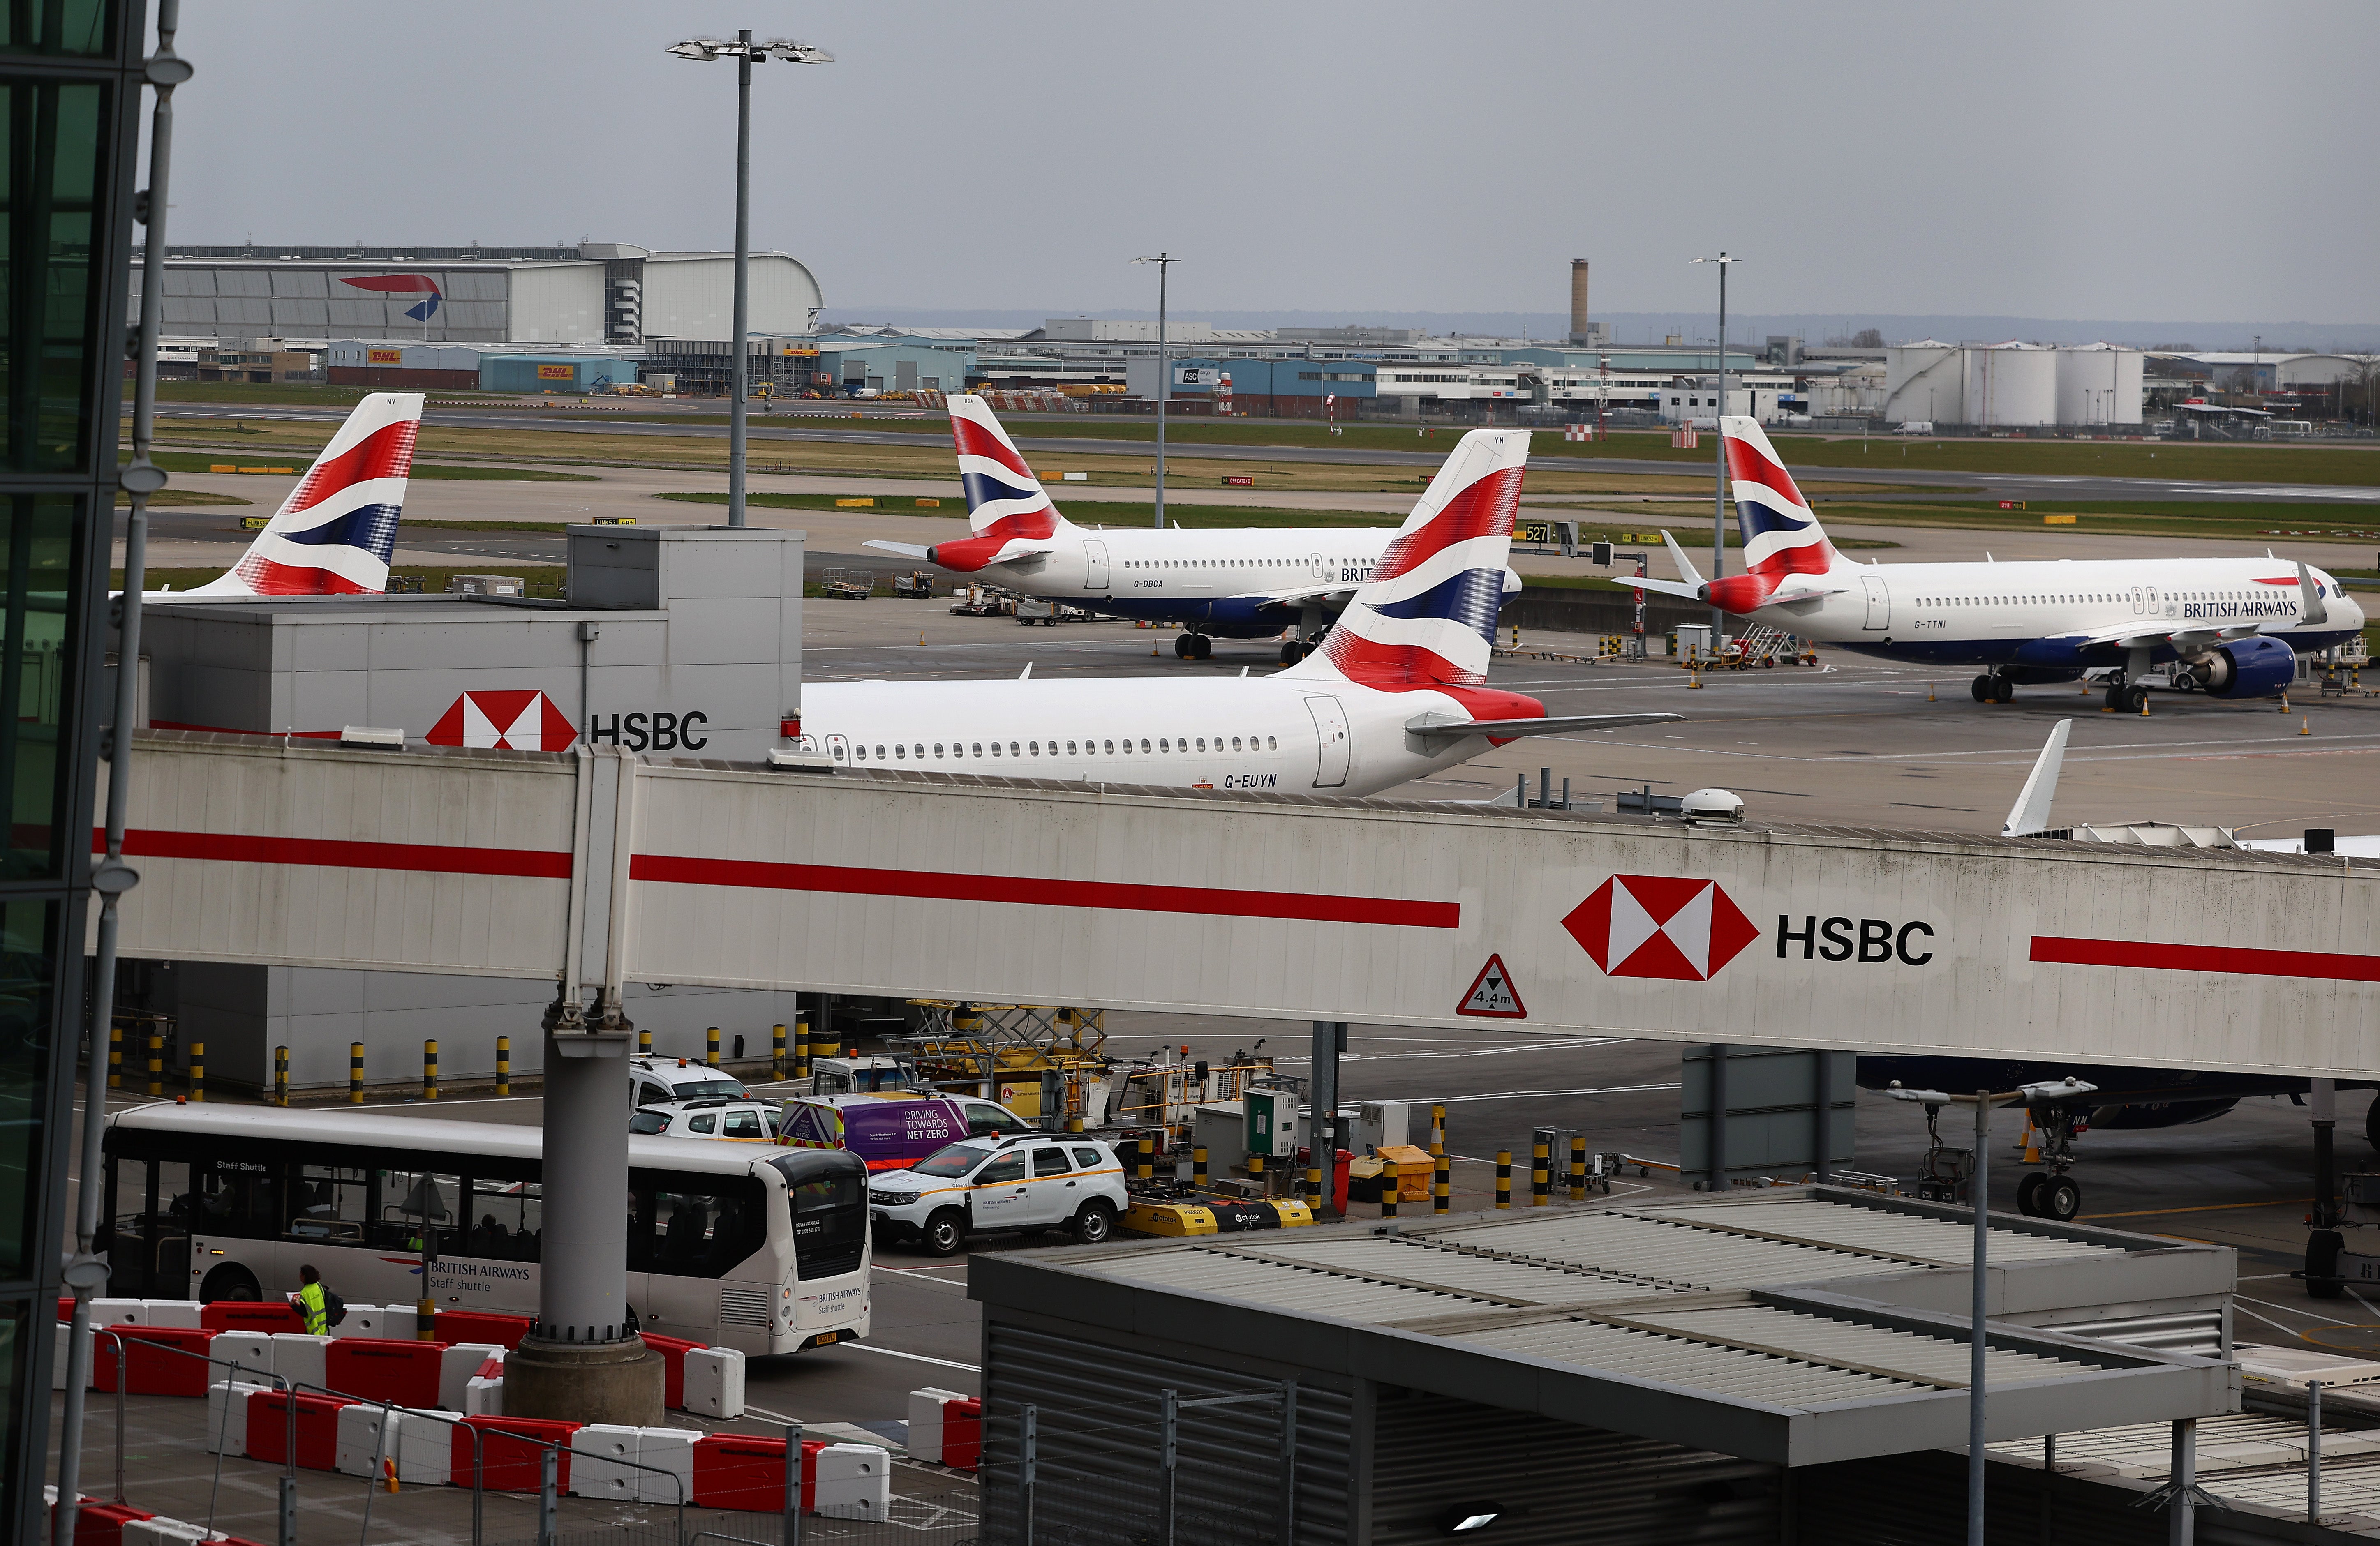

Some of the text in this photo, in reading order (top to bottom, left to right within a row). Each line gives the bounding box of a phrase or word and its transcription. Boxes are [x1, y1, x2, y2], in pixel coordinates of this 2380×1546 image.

[372, 352, 396, 361] DHL
[543, 367, 568, 377] DHL
[1527, 526, 1546, 540] 527
[2184, 601, 2297, 617] BRITISH AIRWAYS
[1915, 620, 1946, 628] G-TTNI
[591, 711, 708, 752] HSBC
[1225, 774, 1277, 788] G-EUYN
[1777, 914, 1934, 966] HSBC
[904, 1110, 938, 1119] DRIVING
[2073, 1115, 2088, 1125] NM
[906, 1119, 948, 1129] TOWARDS
[907, 1129, 949, 1140] NET ZERO
[217, 1161, 266, 1172] Staff Shuttle
[431, 1262, 529, 1280] BRITISH AIRWAYS
[430, 1277, 490, 1292] Staff shuttle
[819, 1287, 861, 1303] BRITISH AIRWAYS
[819, 1303, 845, 1314] Staff shuttle
